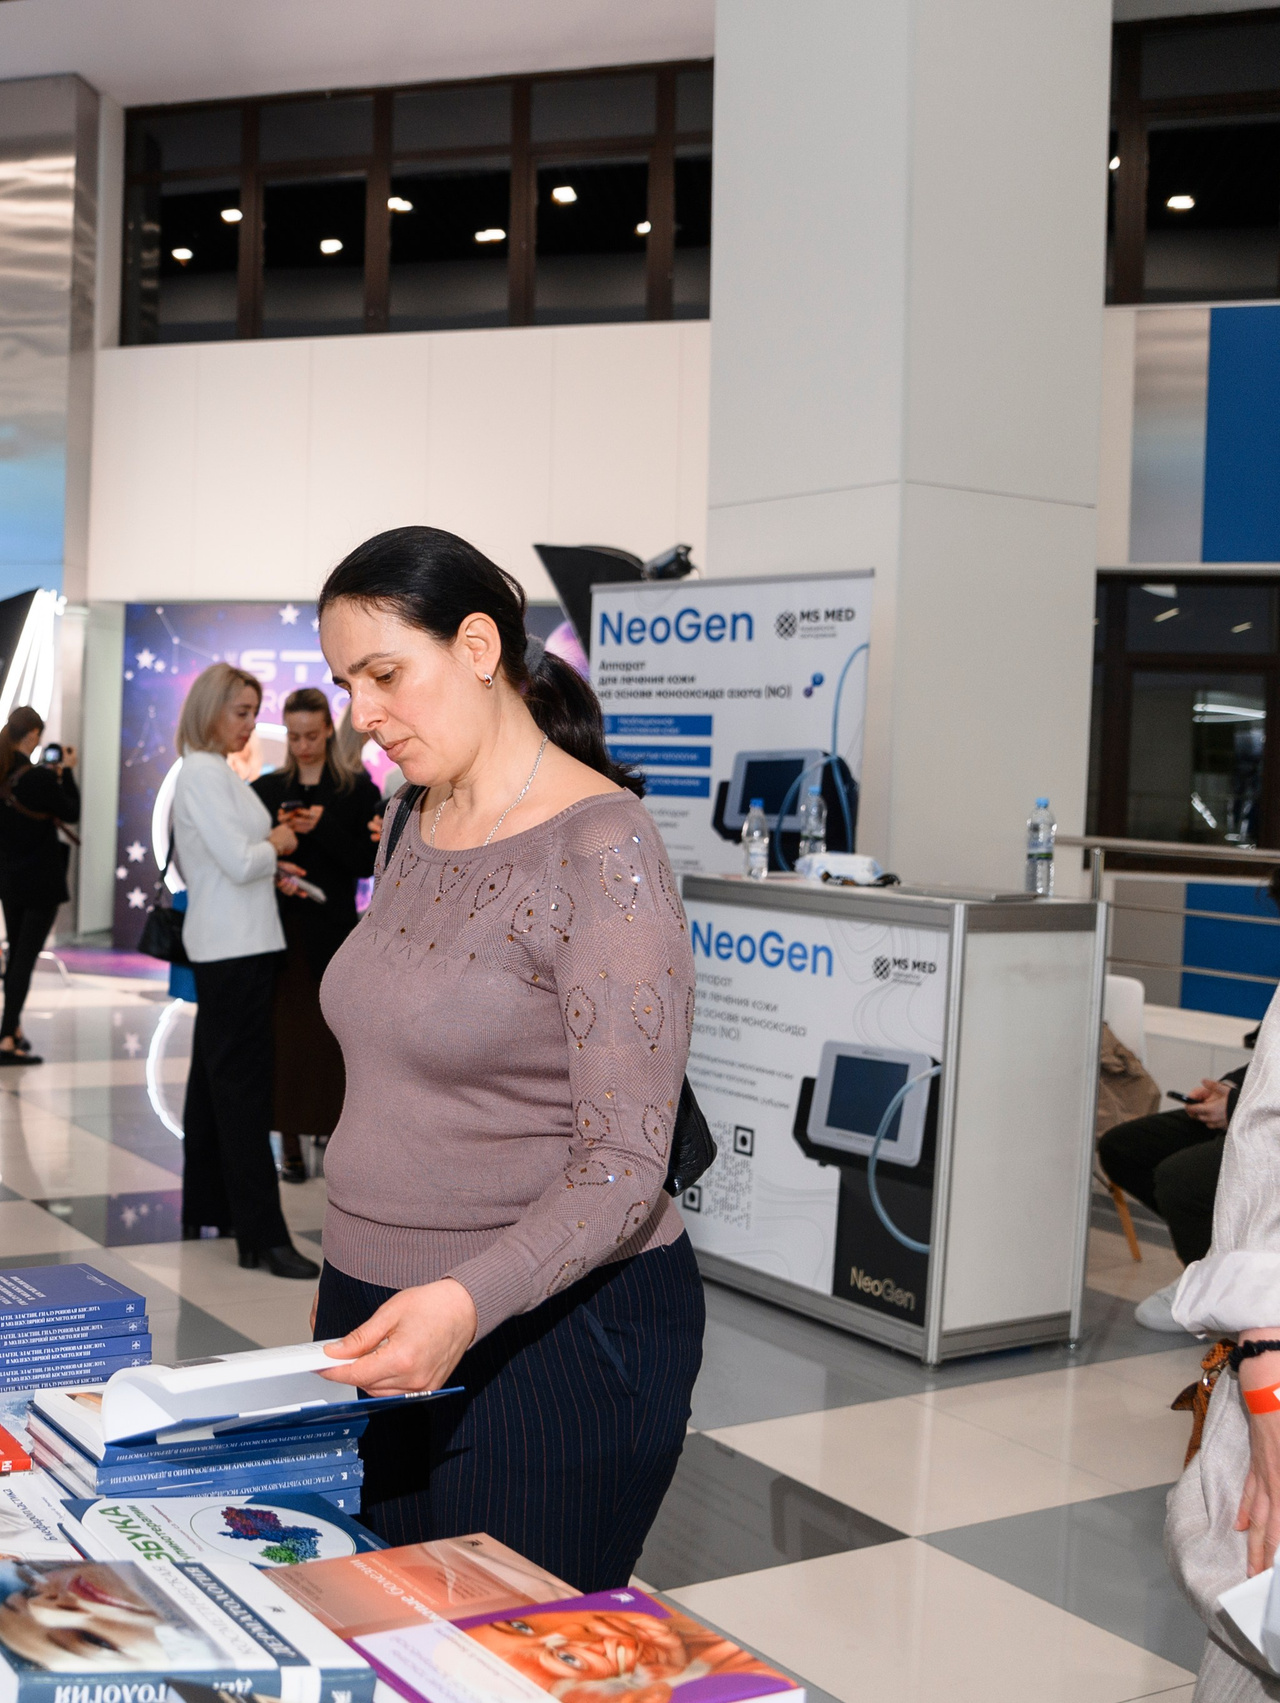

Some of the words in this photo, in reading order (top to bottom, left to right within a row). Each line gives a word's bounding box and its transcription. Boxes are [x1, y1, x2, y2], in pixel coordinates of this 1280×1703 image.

[800, 610, 820, 623] MS
[824, 608, 855, 622] MED
[599, 607, 754, 646] NeoGen
[600, 661, 645, 672] Аппарат
[691, 920, 834, 977] NeoGen
[892, 957, 910, 971] MS
[911, 959, 937, 974] MED
[849, 1265, 916, 1312] NeoGen
[232, 1454, 297, 1469] УЛЬТРАЗВУКОВОМУ
[298, 1453, 309, 1461] ПО
[310, 1451, 328, 1460] АТЛАС
[110, 1470, 167, 1485] ДЕРМАТОЛОГИИ
[167, 1470, 173, 1478] В
[174, 1463, 231, 1477] ИССЛЕДОВАНИЮ
[303, 1477, 312, 1486] ПО
[313, 1474, 335, 1484] АТЛАС
[239, 1478, 302, 1496] УЛЬТРАЗВУКОВОМУ
[2, 1489, 58, 1541] Блефаропластика
[98, 1505, 177, 1564] ЗБУКА
[350, 1559, 404, 1598] болезни
[183, 1565, 297, 1659] ДЕРМАТОЛОГИЯ
